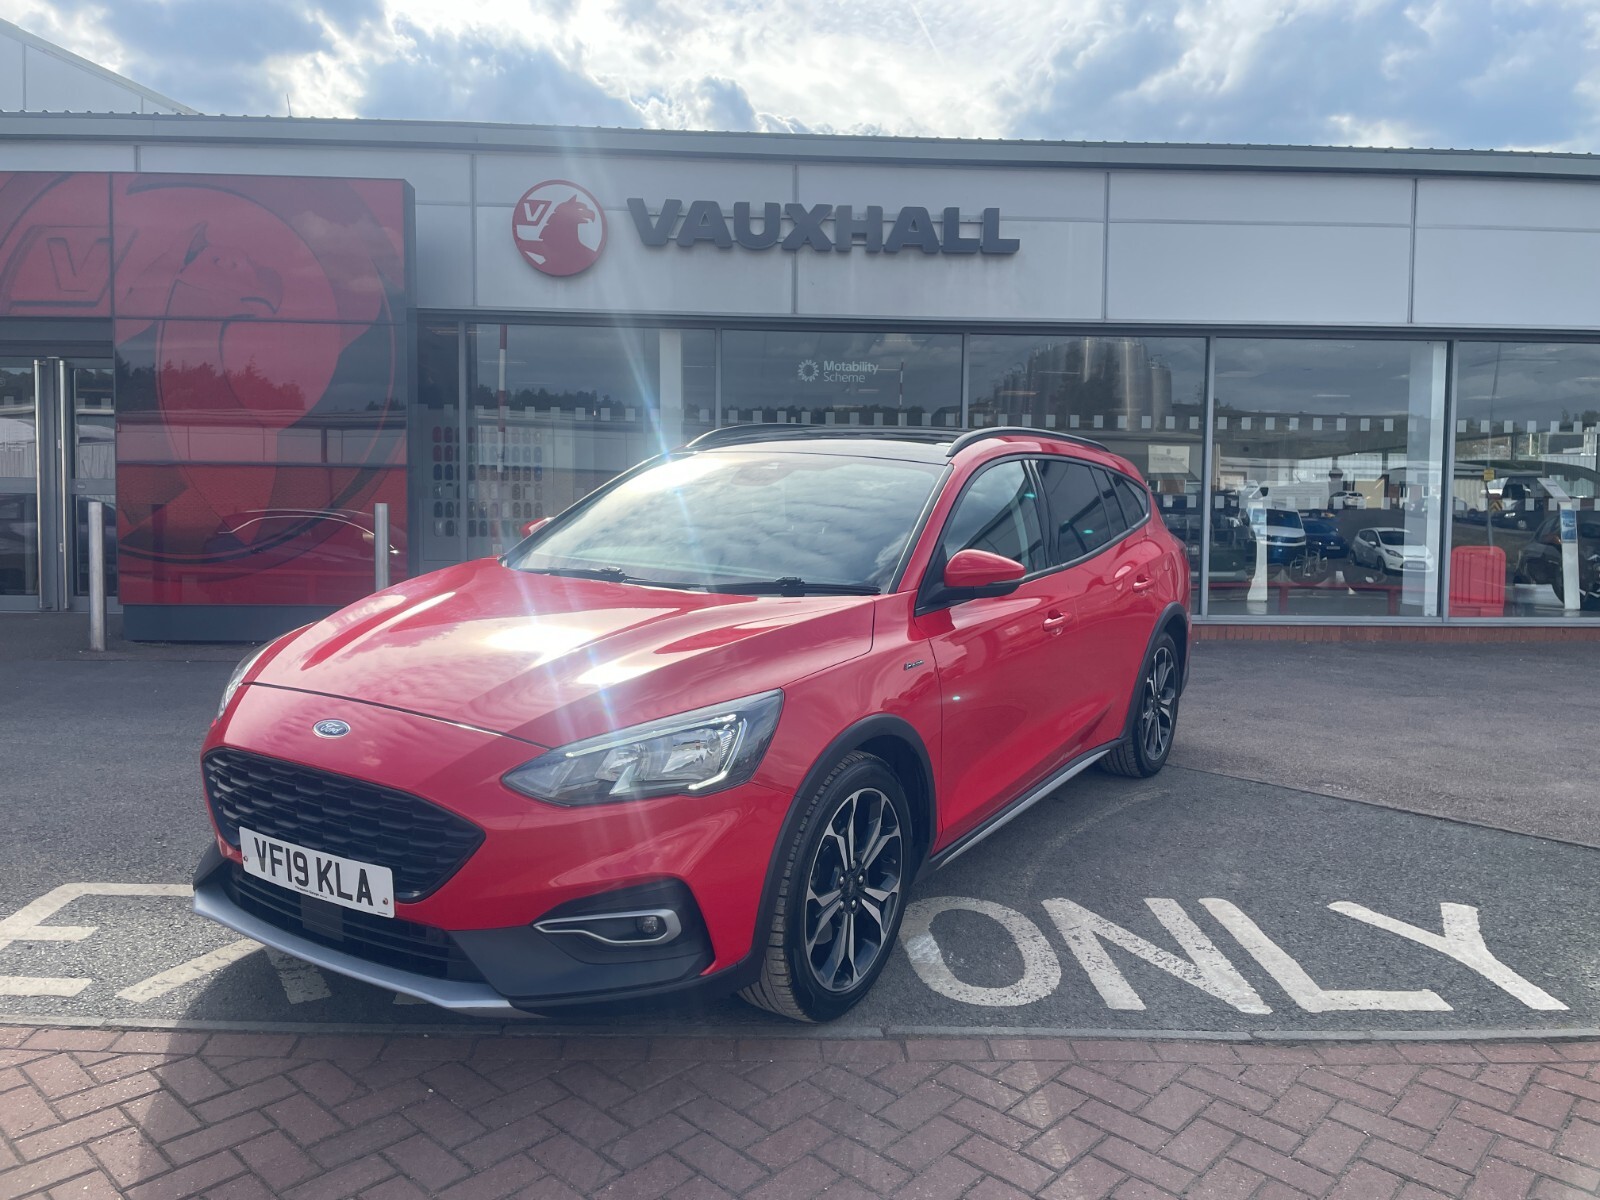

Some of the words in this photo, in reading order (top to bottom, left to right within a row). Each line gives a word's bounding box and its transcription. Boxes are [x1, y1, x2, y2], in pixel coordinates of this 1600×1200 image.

[626, 197, 1020, 255] VAUXHALL
[823, 360, 879, 375] Motability
[823, 371, 866, 383] Scheme
[253, 836, 310, 888] VF19
[315, 856, 374, 907] KLA
[899, 895, 1570, 1014] ONLY
